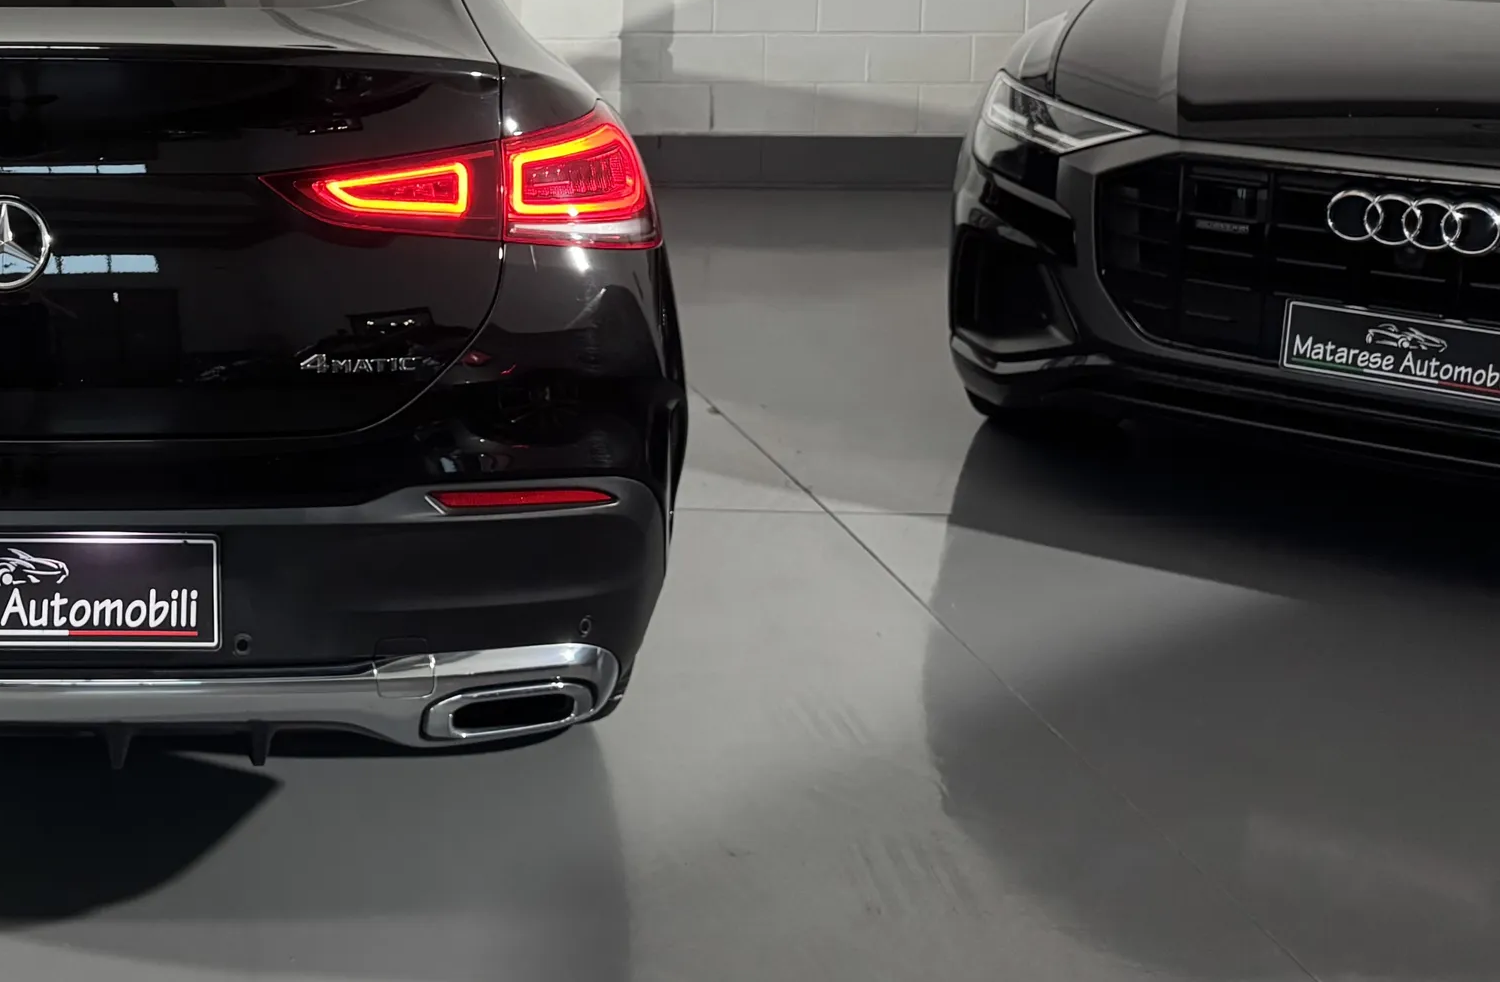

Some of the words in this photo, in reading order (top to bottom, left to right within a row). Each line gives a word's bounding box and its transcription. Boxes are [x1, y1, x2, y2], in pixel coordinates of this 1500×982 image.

[299, 353, 418, 374] 4MATIC
[1292, 333, 1396, 372] Matarese
[1398, 350, 1500, 389] Automob
[0, 588, 198, 628] Automobili
